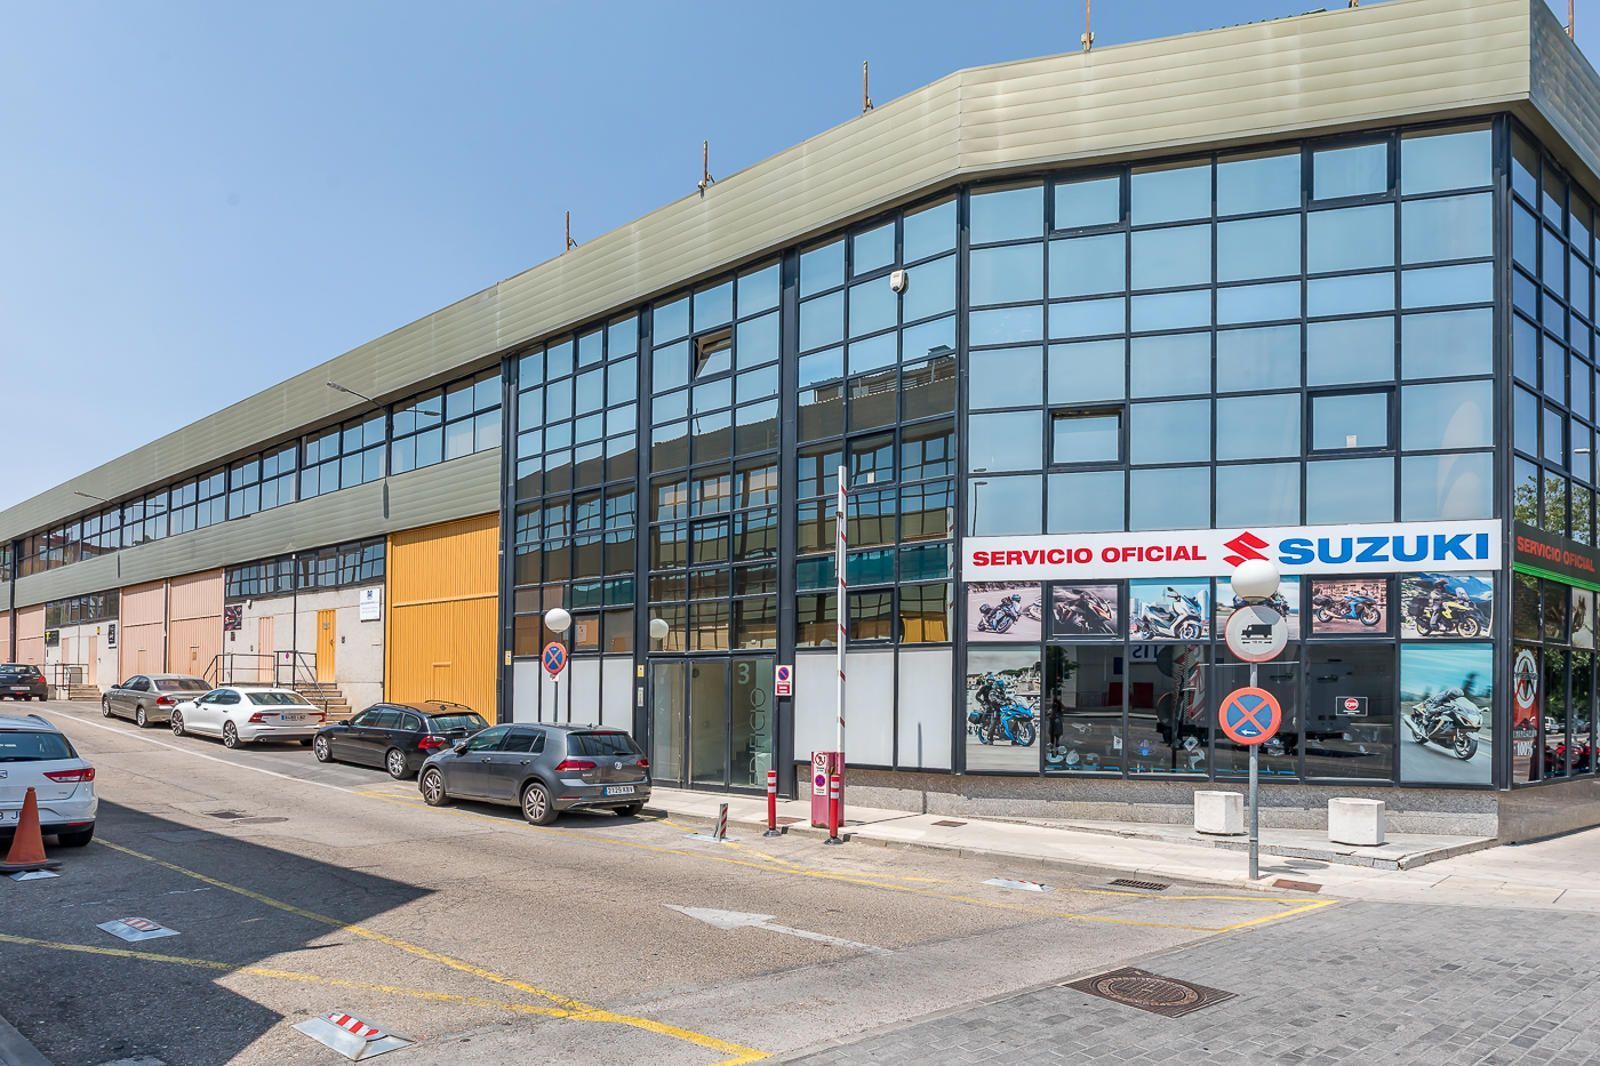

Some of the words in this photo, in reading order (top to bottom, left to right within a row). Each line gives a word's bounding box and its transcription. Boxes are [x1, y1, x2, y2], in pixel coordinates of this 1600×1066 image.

[972, 548, 1093, 566] SERVICIO
[1101, 545, 1207, 564] OFICIAL
[1278, 533, 1488, 565] SUZUKI
[1516, 535, 1561, 562] SERVICIO
[1563, 551, 1596, 573] OFICIAL
[738, 663, 749, 685] 3
